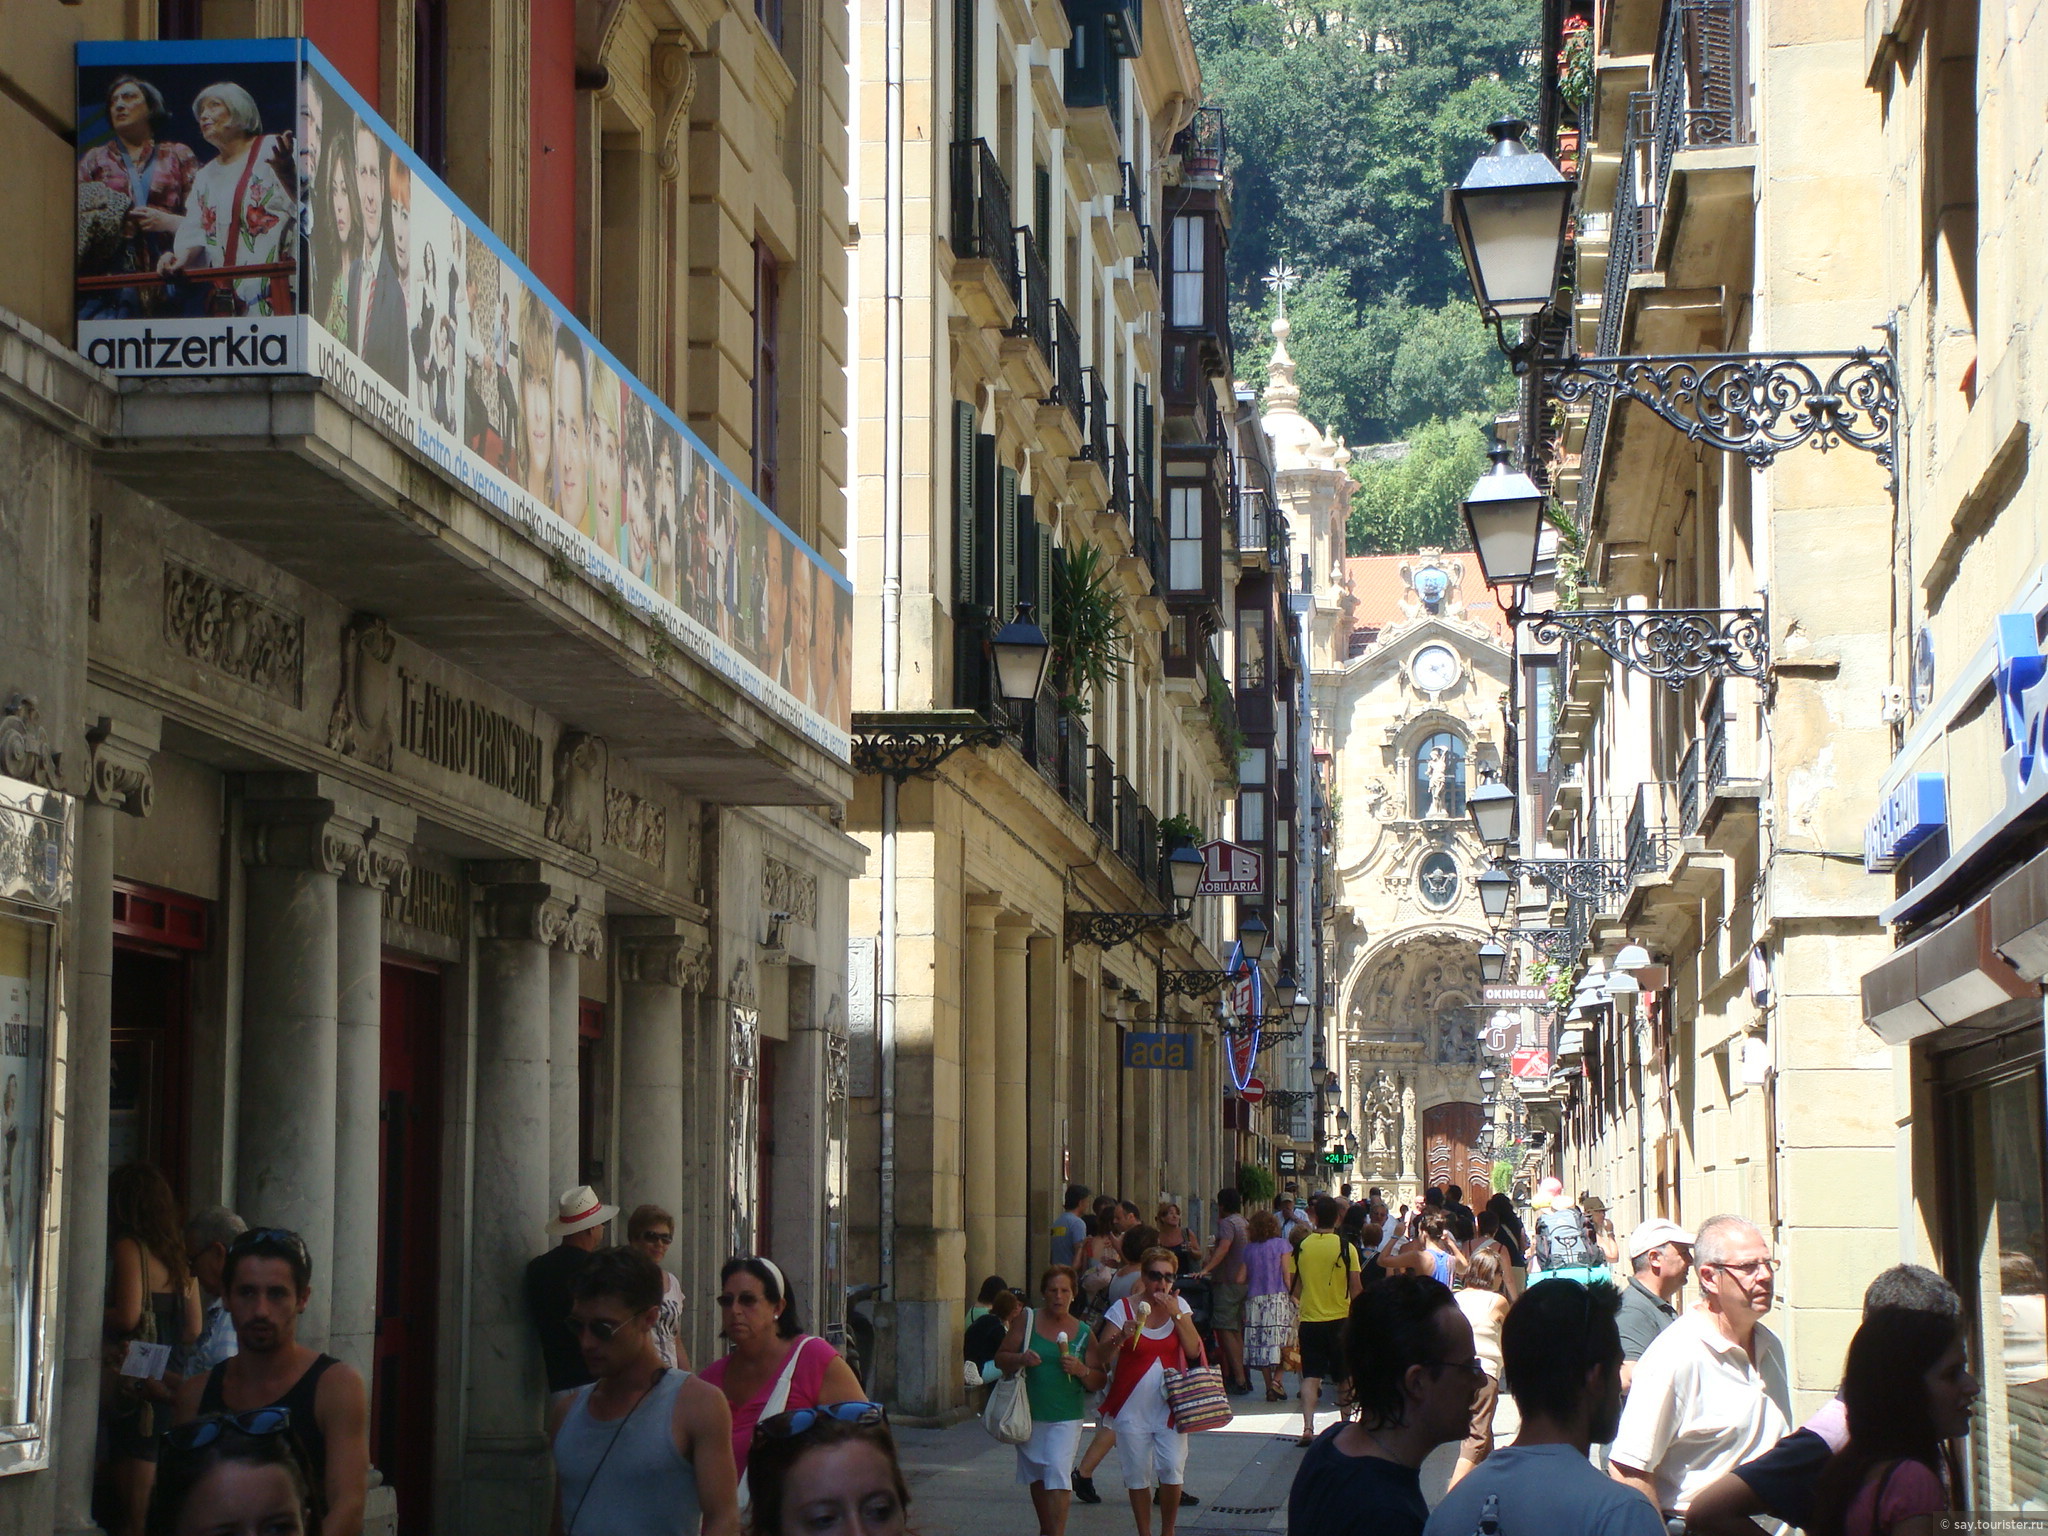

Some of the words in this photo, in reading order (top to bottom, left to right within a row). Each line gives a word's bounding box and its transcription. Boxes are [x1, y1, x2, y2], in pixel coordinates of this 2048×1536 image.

[88, 324, 288, 369] antzerkia
[318, 343, 357, 399] udako
[361, 379, 415, 445] antzerkia
[418, 417, 451, 472] teatro
[454, 450, 469, 484] de
[472, 467, 509, 513] verano
[512, 496, 543, 537] udako
[545, 520, 586, 567] antzerkia
[588, 545, 612, 580] teatro
[614, 569, 624, 592] de
[626, 582, 652, 613] verano
[712, 640, 731, 677] teatro
[732, 656, 740, 683] de
[741, 668, 761, 699] verano
[804, 711, 822, 743] teatro
[821, 725, 828, 749] de
[829, 735, 848, 760] verano
[398, 667, 469, 775] TEATRO
[470, 700, 548, 812] PRINCIPAL
[1485, 989, 1546, 1000] OKINDEGIA
[1131, 1036, 1184, 1067] ada
[1325, 1154, 1353, 1164] +24.0°
